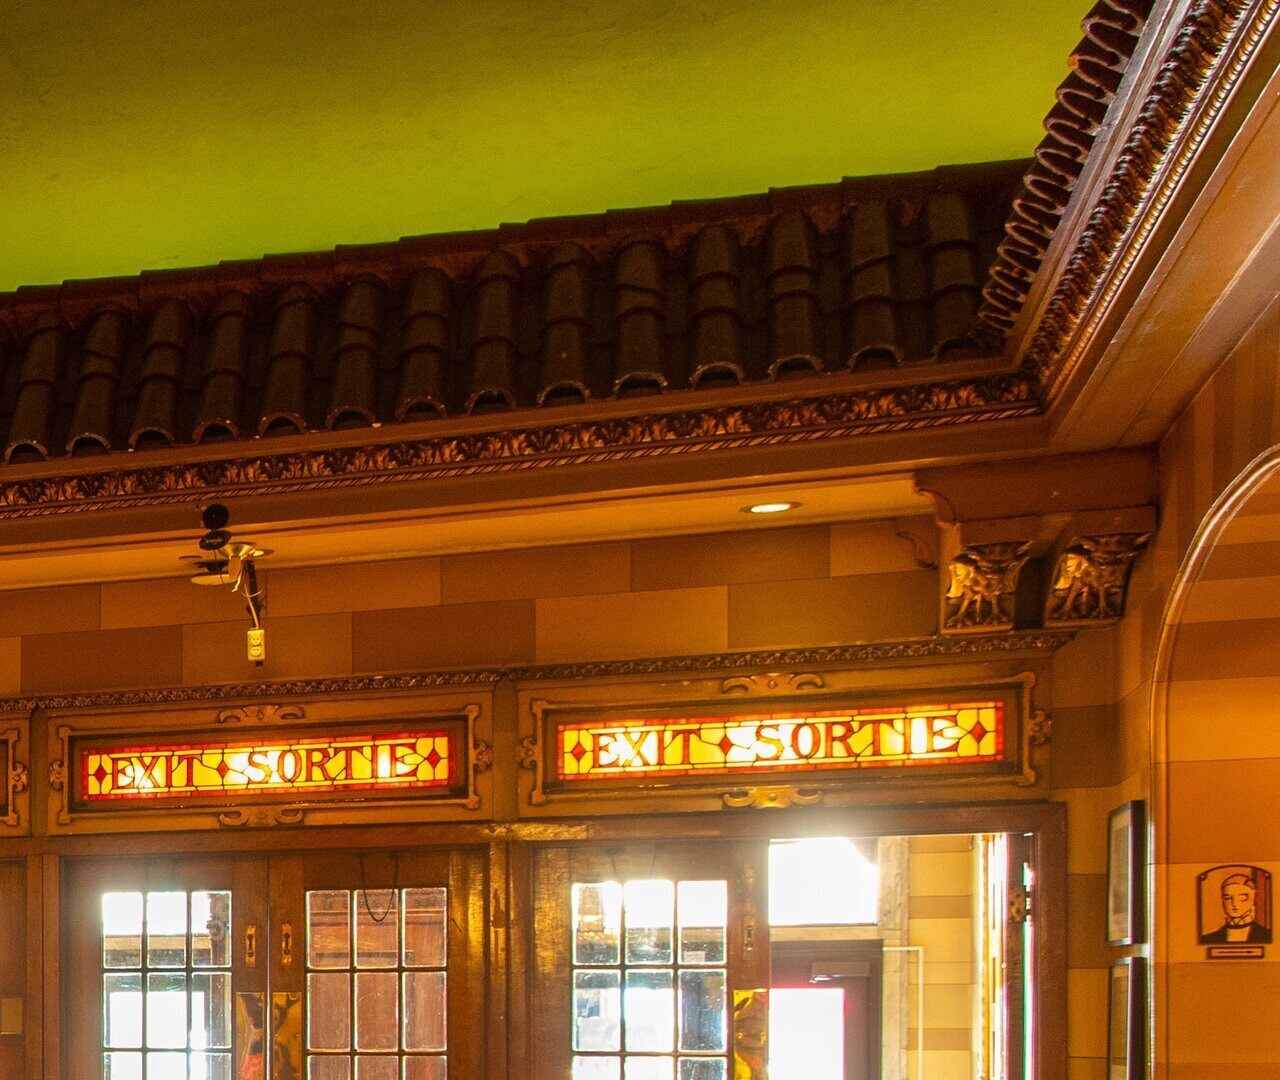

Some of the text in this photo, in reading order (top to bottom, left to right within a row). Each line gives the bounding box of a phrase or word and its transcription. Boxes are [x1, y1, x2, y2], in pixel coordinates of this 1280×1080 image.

[593, 716, 958, 767] EXIT SORTIE
[112, 744, 417, 788] EXIT SORTIE
